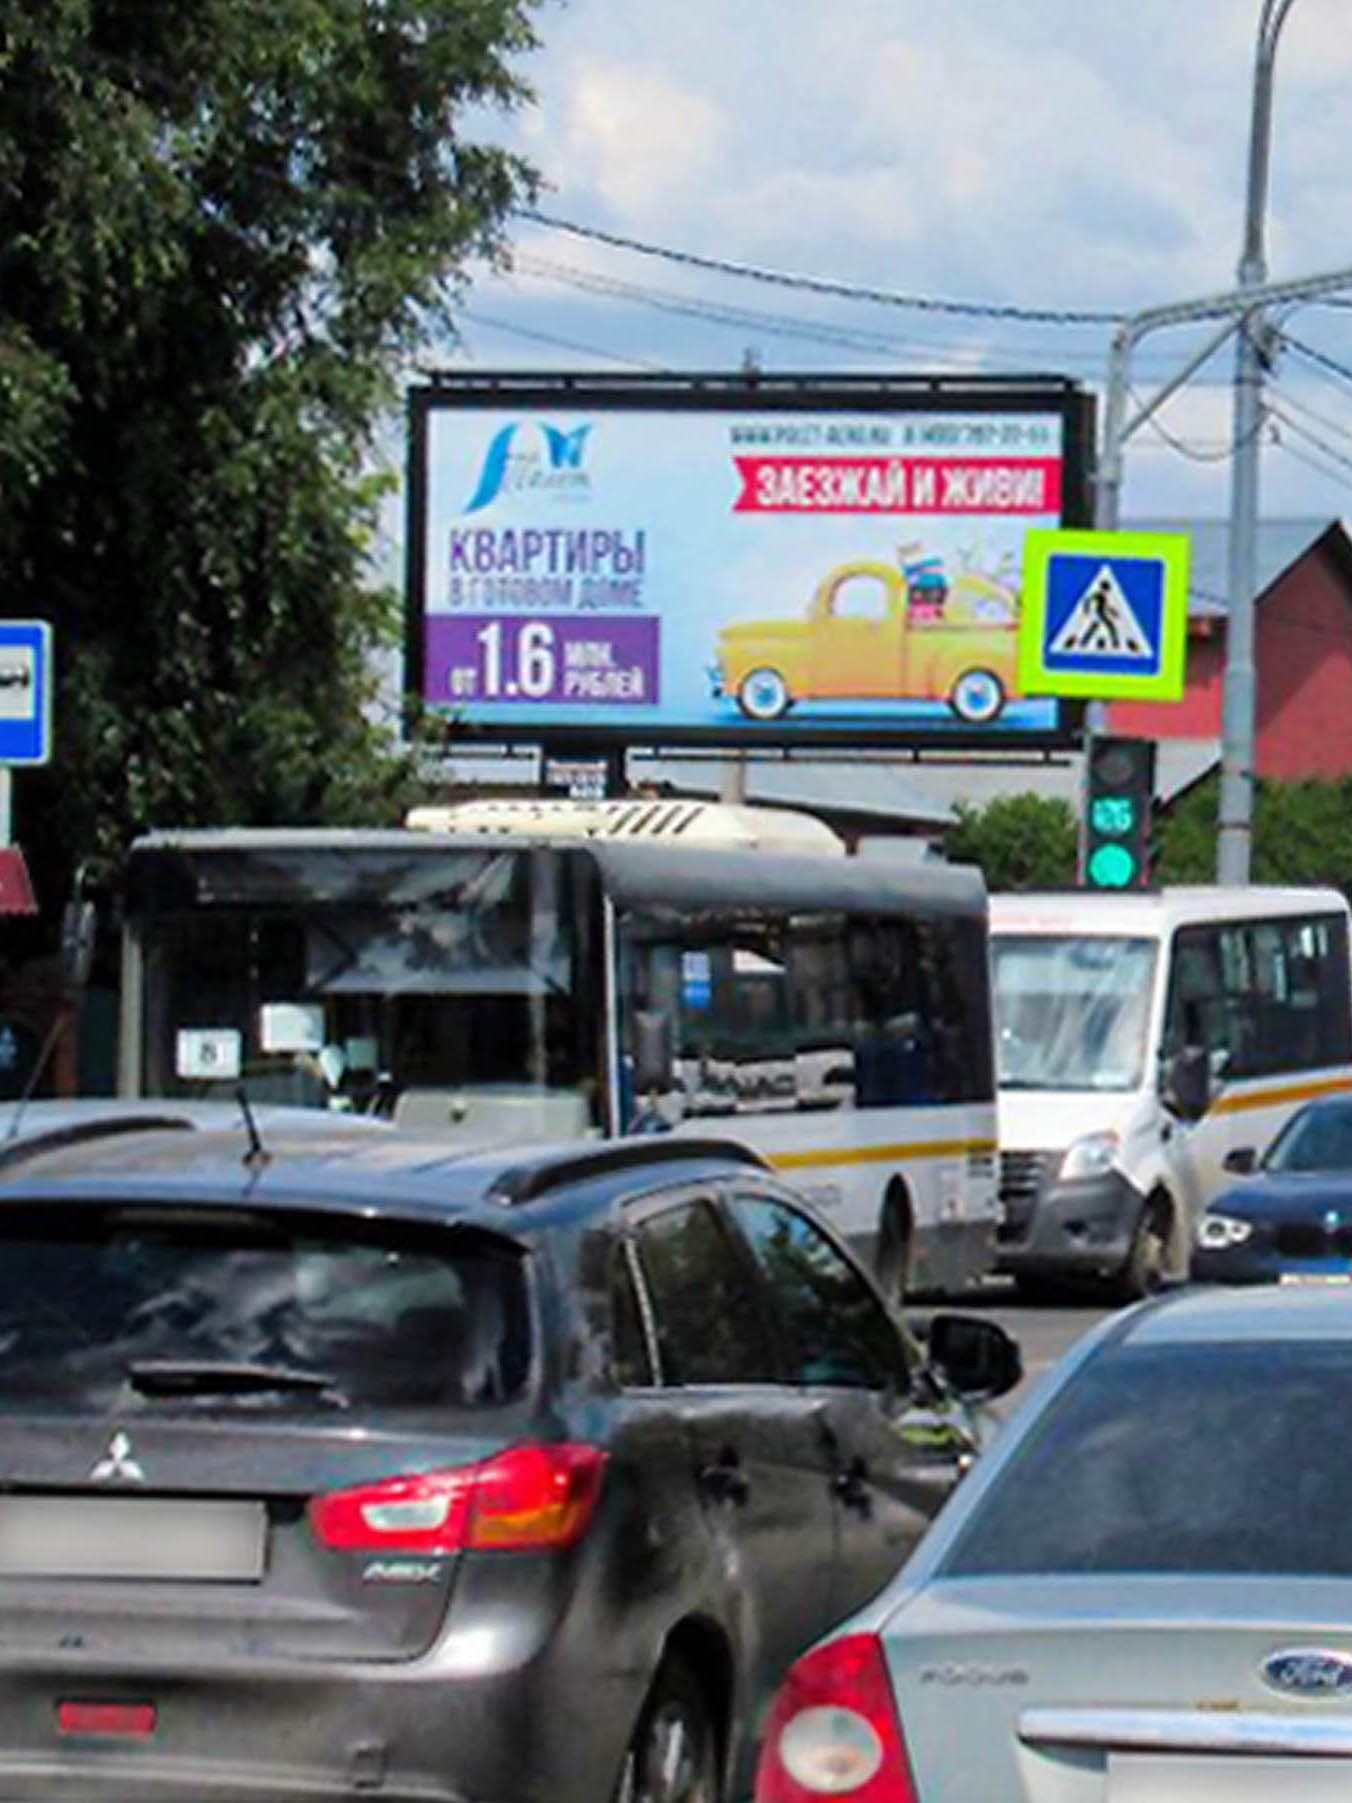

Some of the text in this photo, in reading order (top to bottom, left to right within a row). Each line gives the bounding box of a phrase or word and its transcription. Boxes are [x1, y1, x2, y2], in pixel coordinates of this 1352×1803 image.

[757, 460, 1045, 507] ЗАЕЗЖАЙ И ЖИВИ!
[450, 529, 645, 573] КВАРТИРЫ
[450, 577, 645, 609] В ГОТОВОМ ДОМЕ
[476, 620, 556, 698] 1.6
[562, 666, 646, 698] РУБЛЕЙ
[361, 1562, 441, 1582] ASX
[1279, 1658, 1346, 1688] Ford
